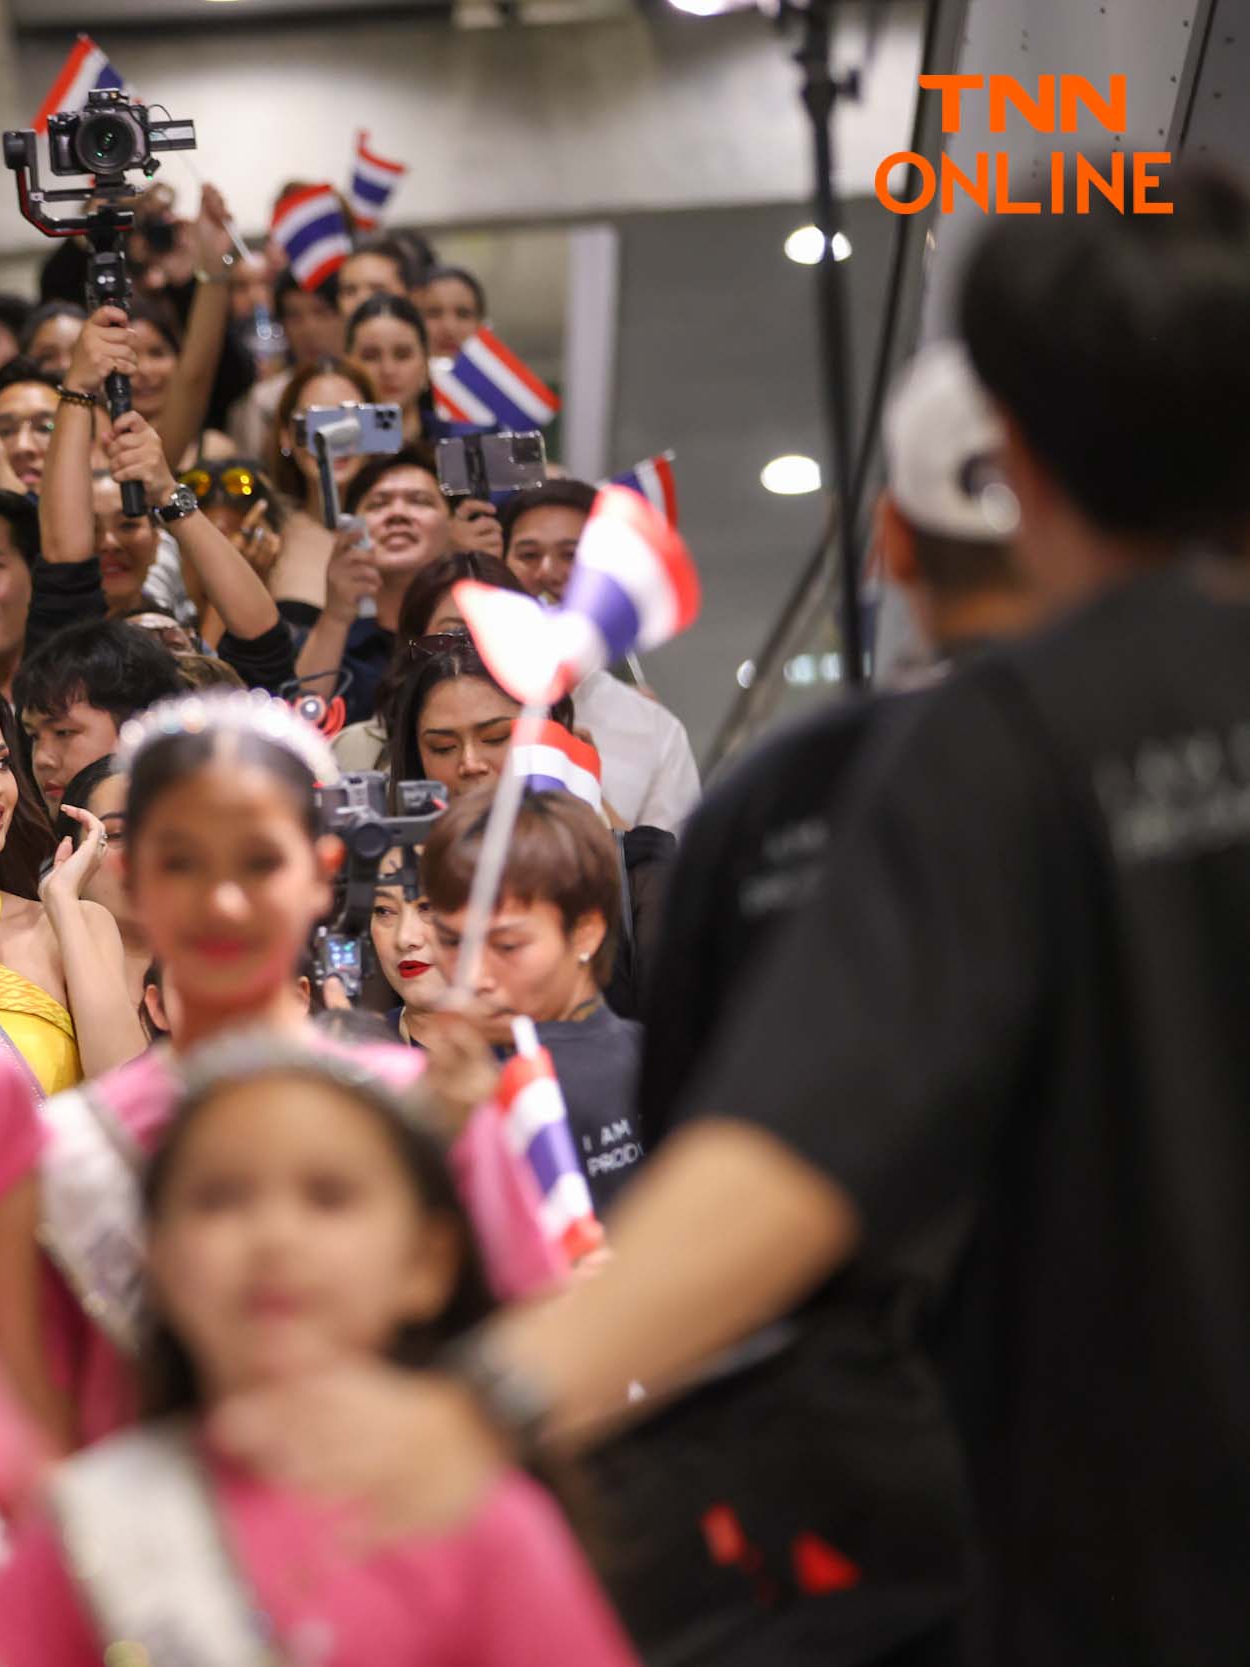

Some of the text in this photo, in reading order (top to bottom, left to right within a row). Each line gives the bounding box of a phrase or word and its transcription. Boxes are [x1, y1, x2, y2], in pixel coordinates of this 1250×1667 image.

[582, 1118, 631, 1152] I AM
[587, 1142, 643, 1177] PROD
